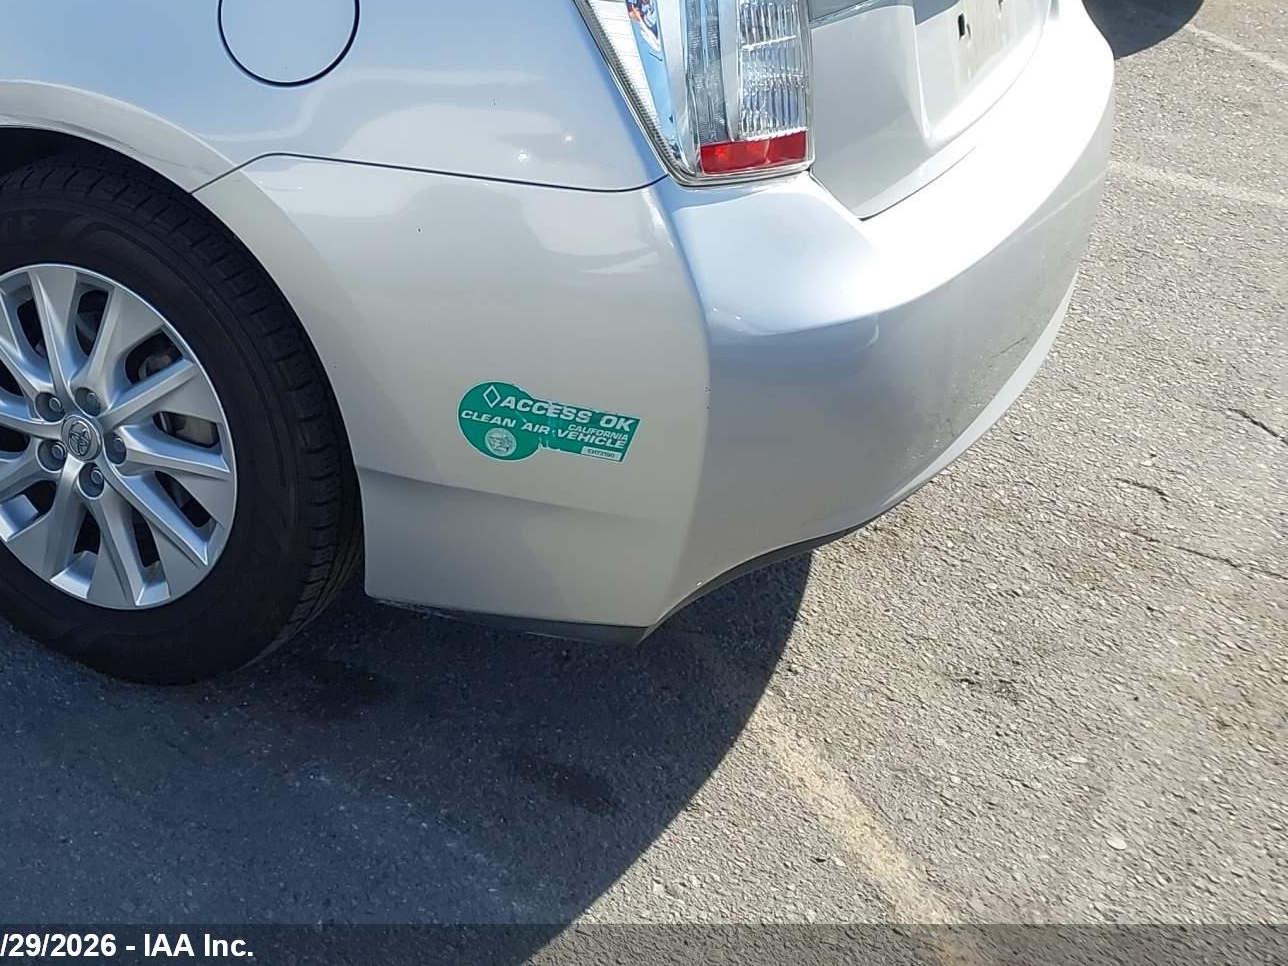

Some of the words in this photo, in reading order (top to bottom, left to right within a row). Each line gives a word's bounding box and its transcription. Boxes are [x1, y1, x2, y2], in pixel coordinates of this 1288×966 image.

[461, 410, 516, 428] CLEAN
[520, 421, 551, 435] AIR
[557, 429, 627, 449] VEHICLE
[499, 396, 593, 423] ACCESS
[599, 415, 636, 432] OK
[568, 424, 629, 441] CALIFORNIA
